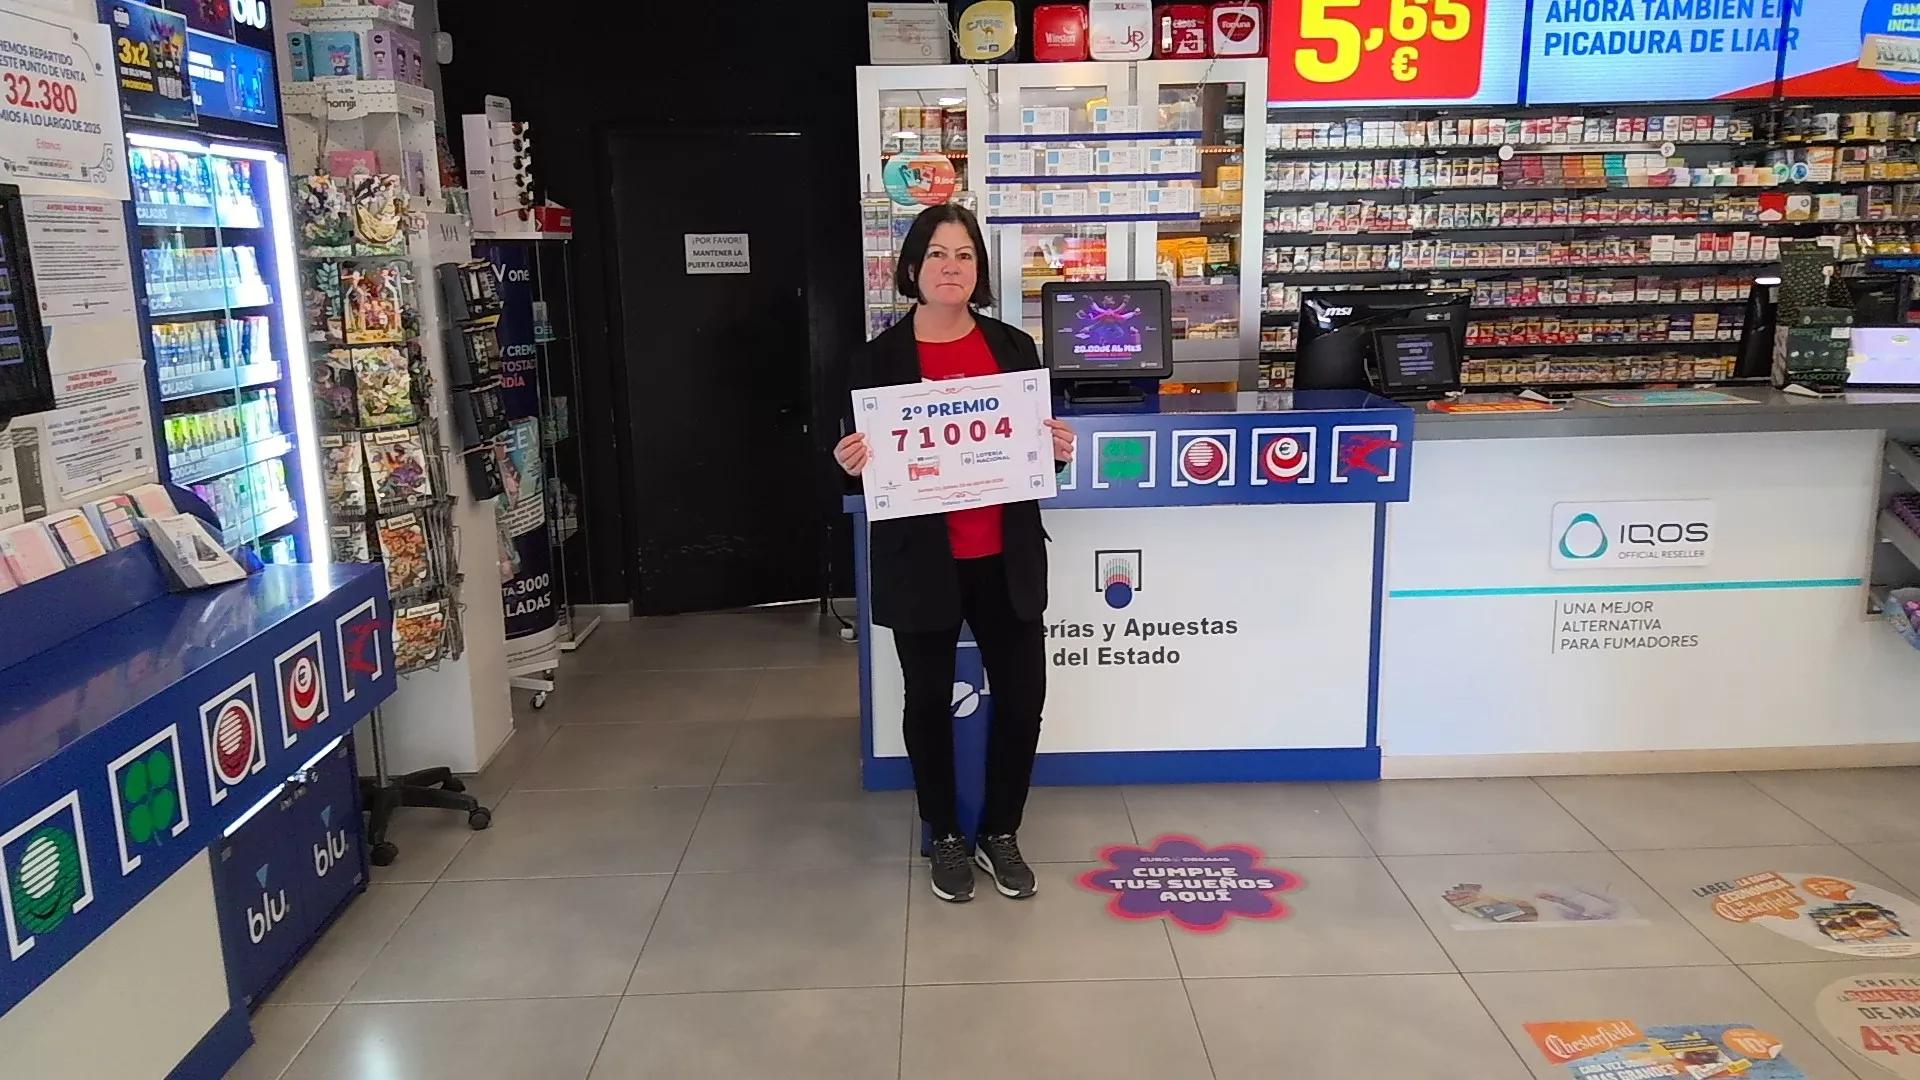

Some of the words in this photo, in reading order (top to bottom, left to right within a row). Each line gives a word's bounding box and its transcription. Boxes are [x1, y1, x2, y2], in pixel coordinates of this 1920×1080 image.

[1546, 0, 1635, 23] AHORA
[1046, 31, 1076, 44] Winston
[1294, 0, 1472, 83] 5,65
[1544, 30, 1683, 56] PICADURA
[1690, 29, 1725, 53] DE
[29, 46, 73, 66] REPARTIDO
[118, 37, 150, 67] 3x2
[20, 59, 48, 75] PUNTO
[49, 65, 60, 78] DE
[61, 69, 87, 83] VENTA
[4, 72, 77, 115] 32.380
[43, 115, 72, 130] LARGO
[692, 249, 732, 257] MANTENER
[508, 268, 530, 281] one
[1325, 306, 1353, 316] msi
[902, 405, 922, 421] 2º
[927, 397, 999, 418] PREMIO
[976, 450, 1003, 459] LOTERÍA
[976, 455, 1010, 464] NACIONAL
[1620, 523, 1709, 546] IQOS
[1618, 551, 1659, 560] OFFICIAL
[1661, 550, 1705, 559] RESELLER
[516, 573, 549, 595] 3000
[1563, 602, 1597, 615] UNA
[1600, 600, 1654, 614] MEJOR
[1103, 623, 1116, 642] y
[1124, 617, 1238, 641] Apuestas
[1561, 618, 1662, 632] ALTERNATIVA
[1561, 638, 1600, 650] PARA
[1603, 635, 1699, 650] FUMADORES
[1053, 647, 1089, 666] del
[1098, 646, 1180, 666] Estado
[1132, 867, 1239, 877] CUMPLE
[1109, 879, 1162, 889] TUS
[1167, 877, 1275, 889] SUEÑOS
[1692, 880, 1735, 898] LABEL
[1159, 889, 1233, 903] AQUÍ
[1715, 889, 1799, 922] Chesterfield
[1858, 1007, 1892, 1019] DE
[1544, 1020, 1637, 1059] Chesterfield
[1617, 1063, 1681, 1080] GRANDES
